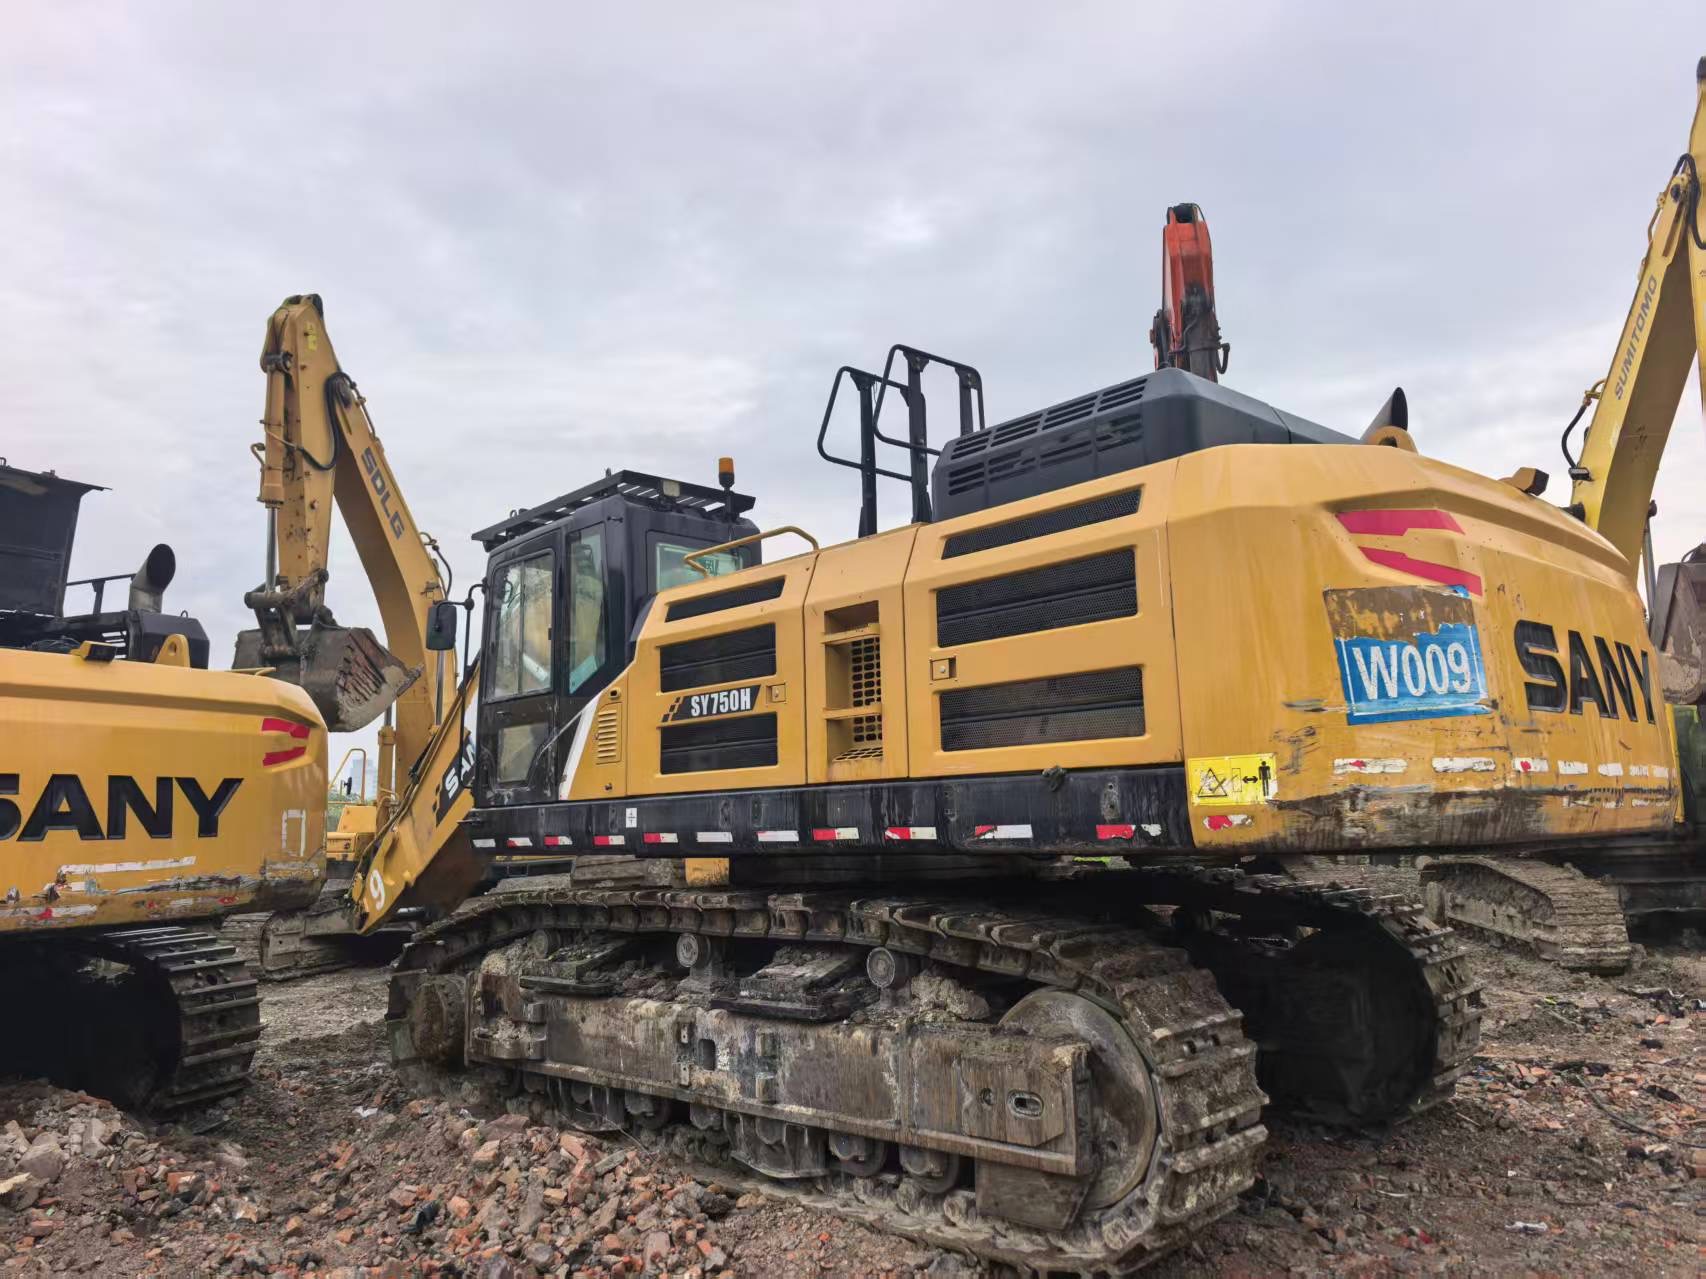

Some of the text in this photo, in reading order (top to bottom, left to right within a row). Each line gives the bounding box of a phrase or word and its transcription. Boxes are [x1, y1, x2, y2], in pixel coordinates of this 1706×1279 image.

[1615, 275, 1657, 400] SUMITOMO
[361, 447, 404, 539] SDLG
[690, 688, 751, 717] SY750H
[1352, 643, 1471, 700] W009
[1514, 619, 1656, 725] SANY
